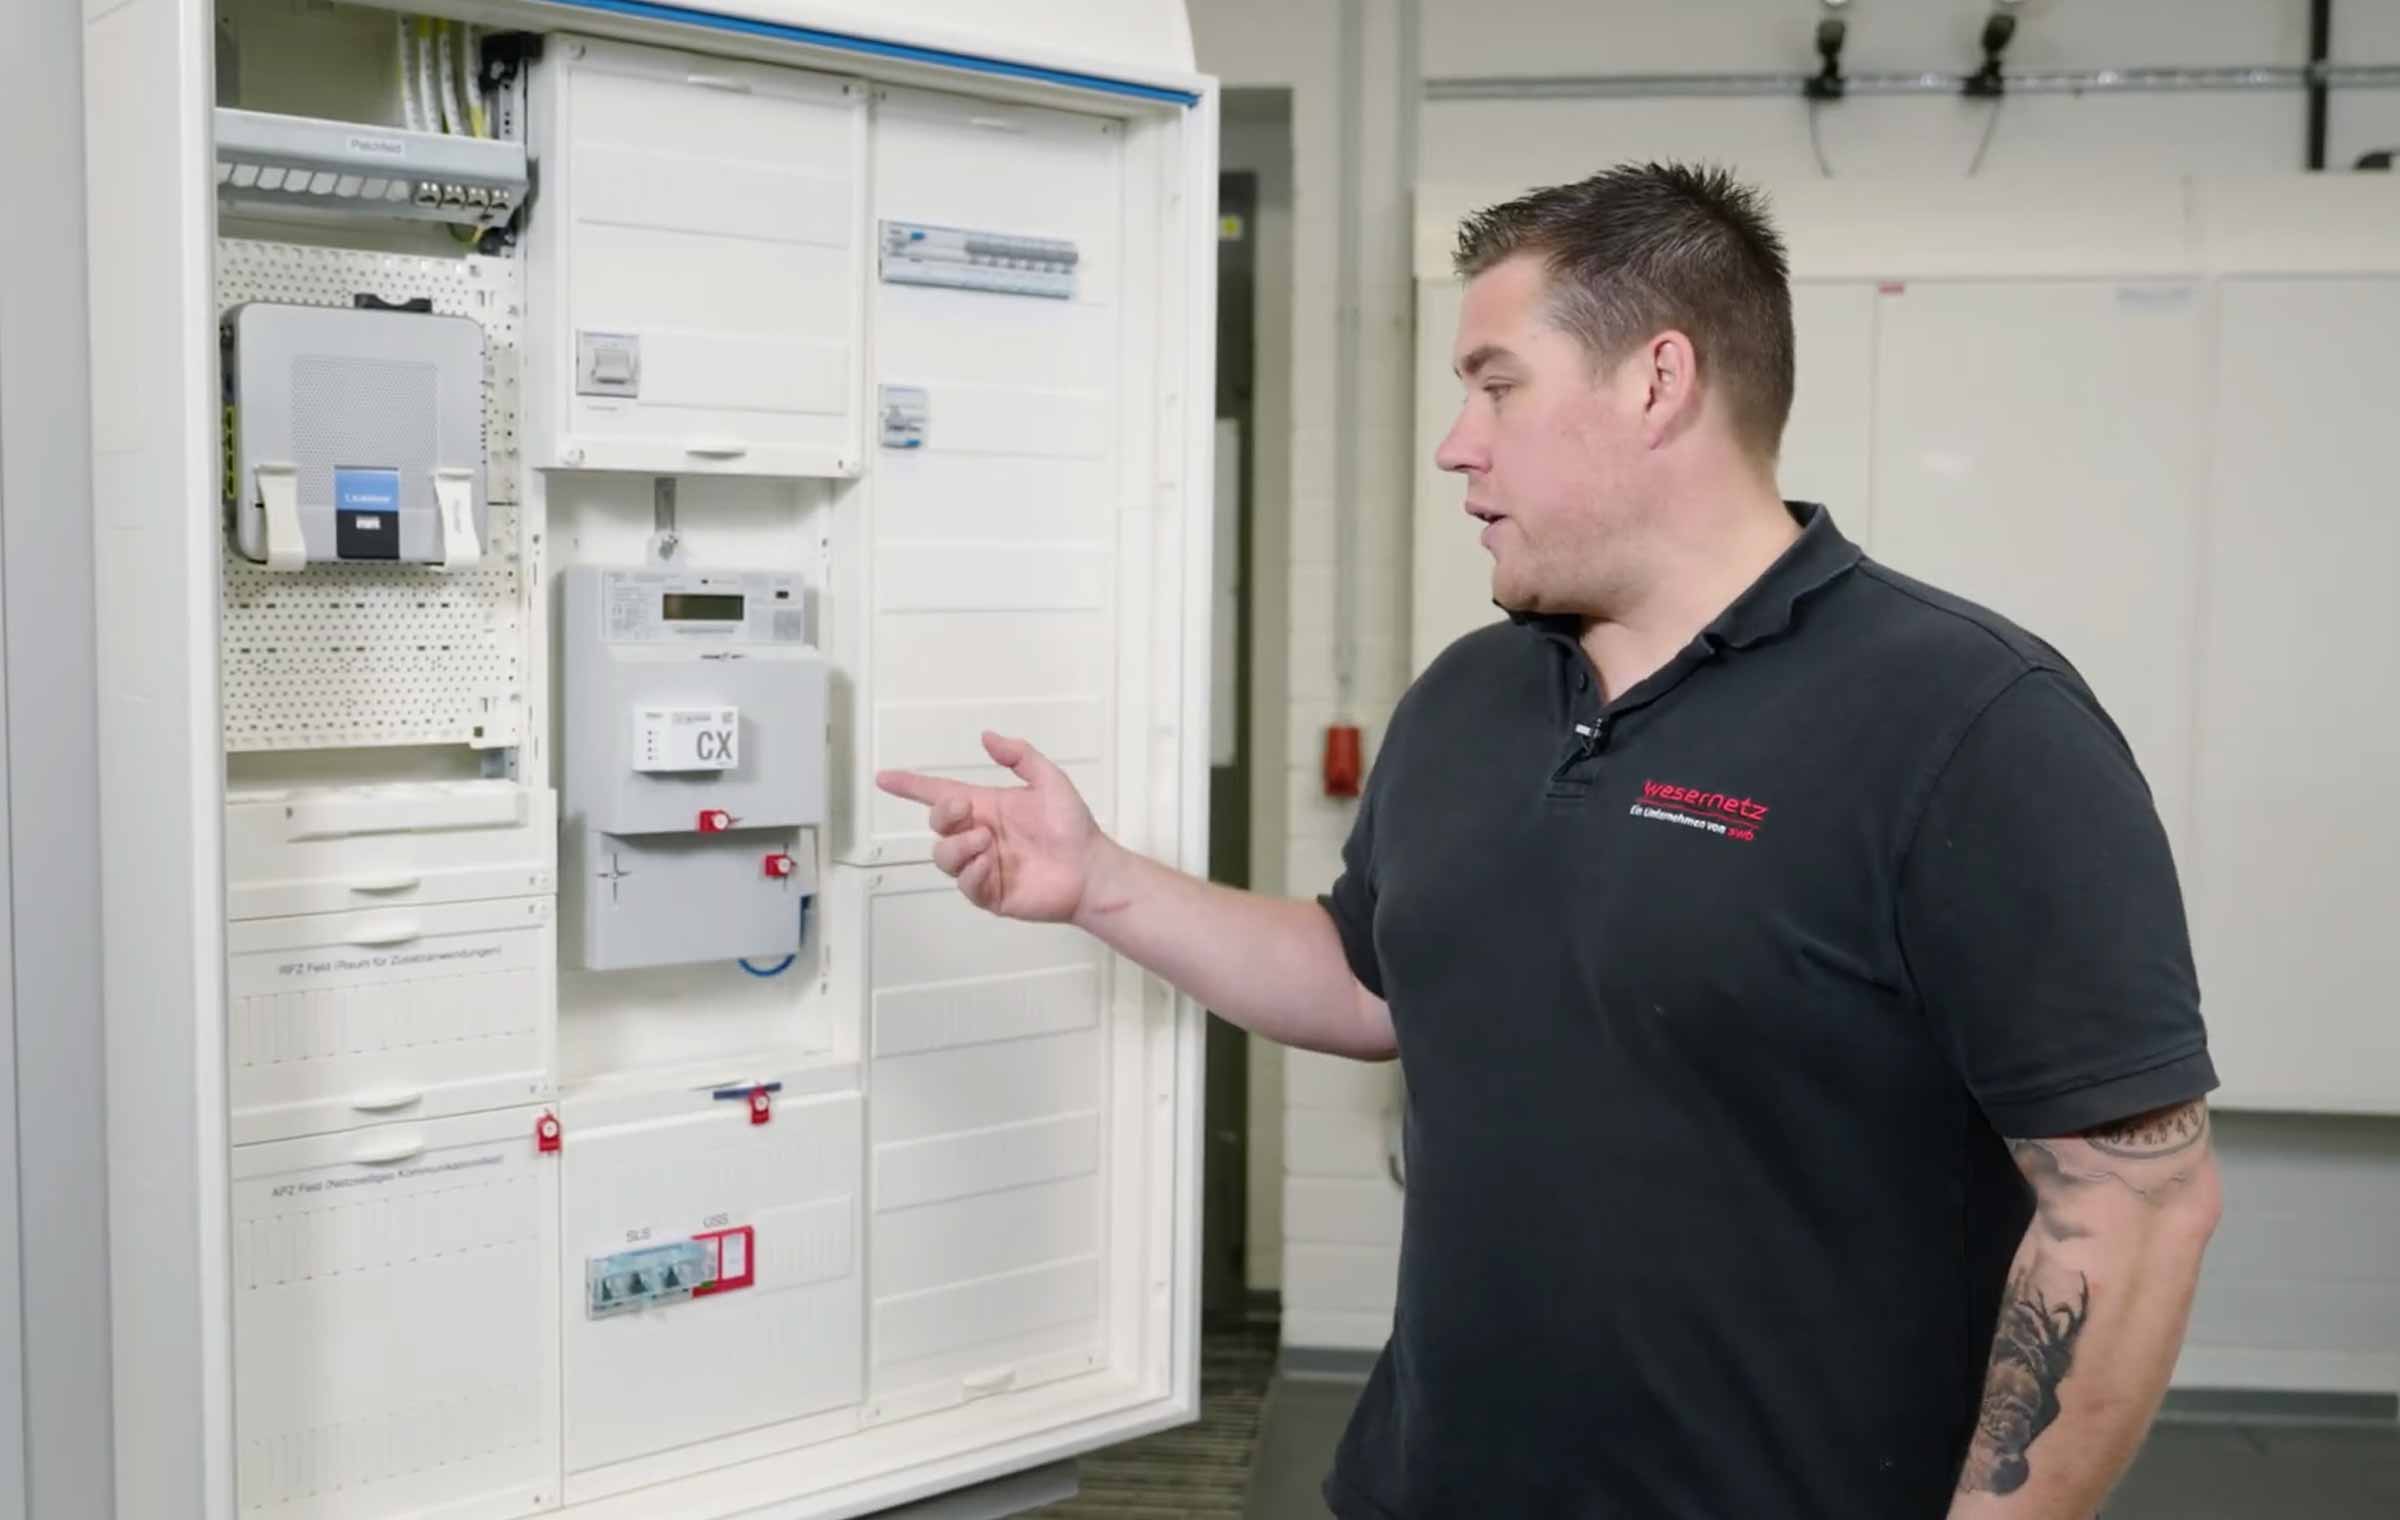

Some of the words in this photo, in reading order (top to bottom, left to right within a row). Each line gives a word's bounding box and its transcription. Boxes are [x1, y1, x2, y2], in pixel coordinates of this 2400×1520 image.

[696, 730, 733, 760] CX
[1643, 780, 1768, 820] wesernetz
[1643, 807, 1706, 829] Unternehmen
[1707, 821, 1727, 835] von
